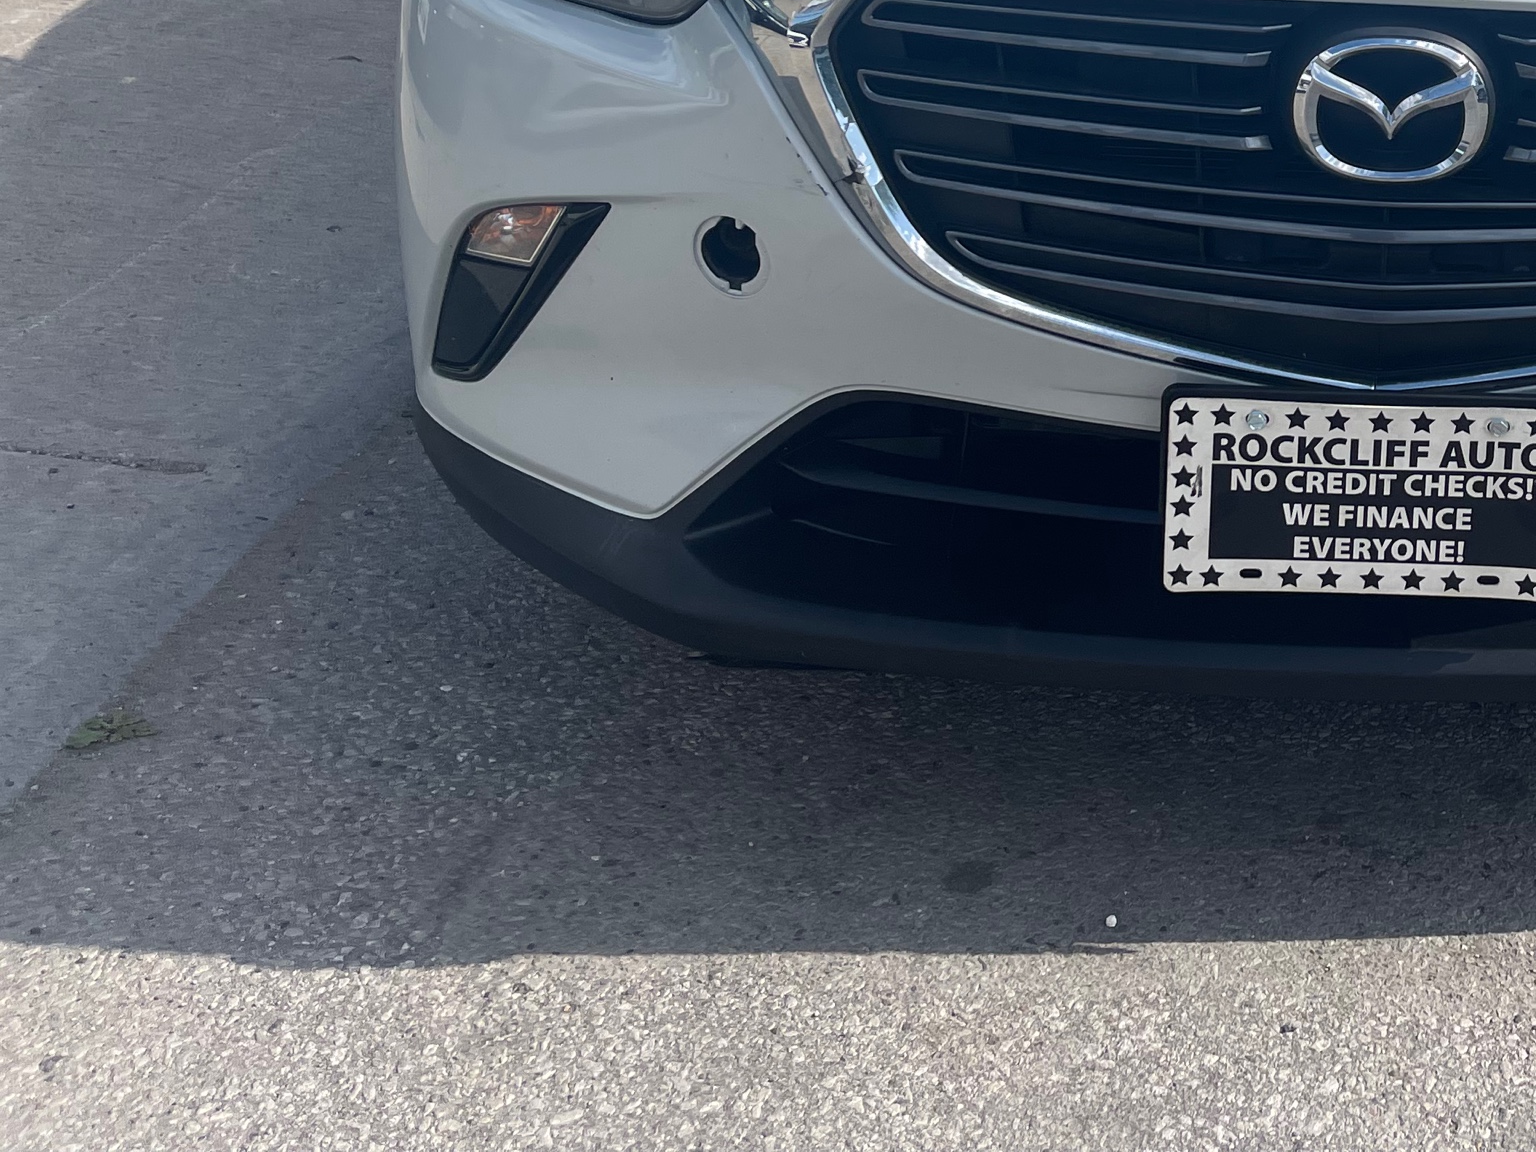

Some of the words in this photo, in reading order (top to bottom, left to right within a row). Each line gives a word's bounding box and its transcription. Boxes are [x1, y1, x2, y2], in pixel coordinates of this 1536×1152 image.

[1210, 432, 1431, 466] ROCKCLIFF
[1229, 467, 1278, 494] NO
[1284, 470, 1398, 496] CREDIT
[1403, 473, 1536, 501] CHECKS!
[1282, 502, 1330, 527] WE
[1337, 504, 1473, 531] FINANCE
[1292, 535, 1465, 563] EVERYONE!
